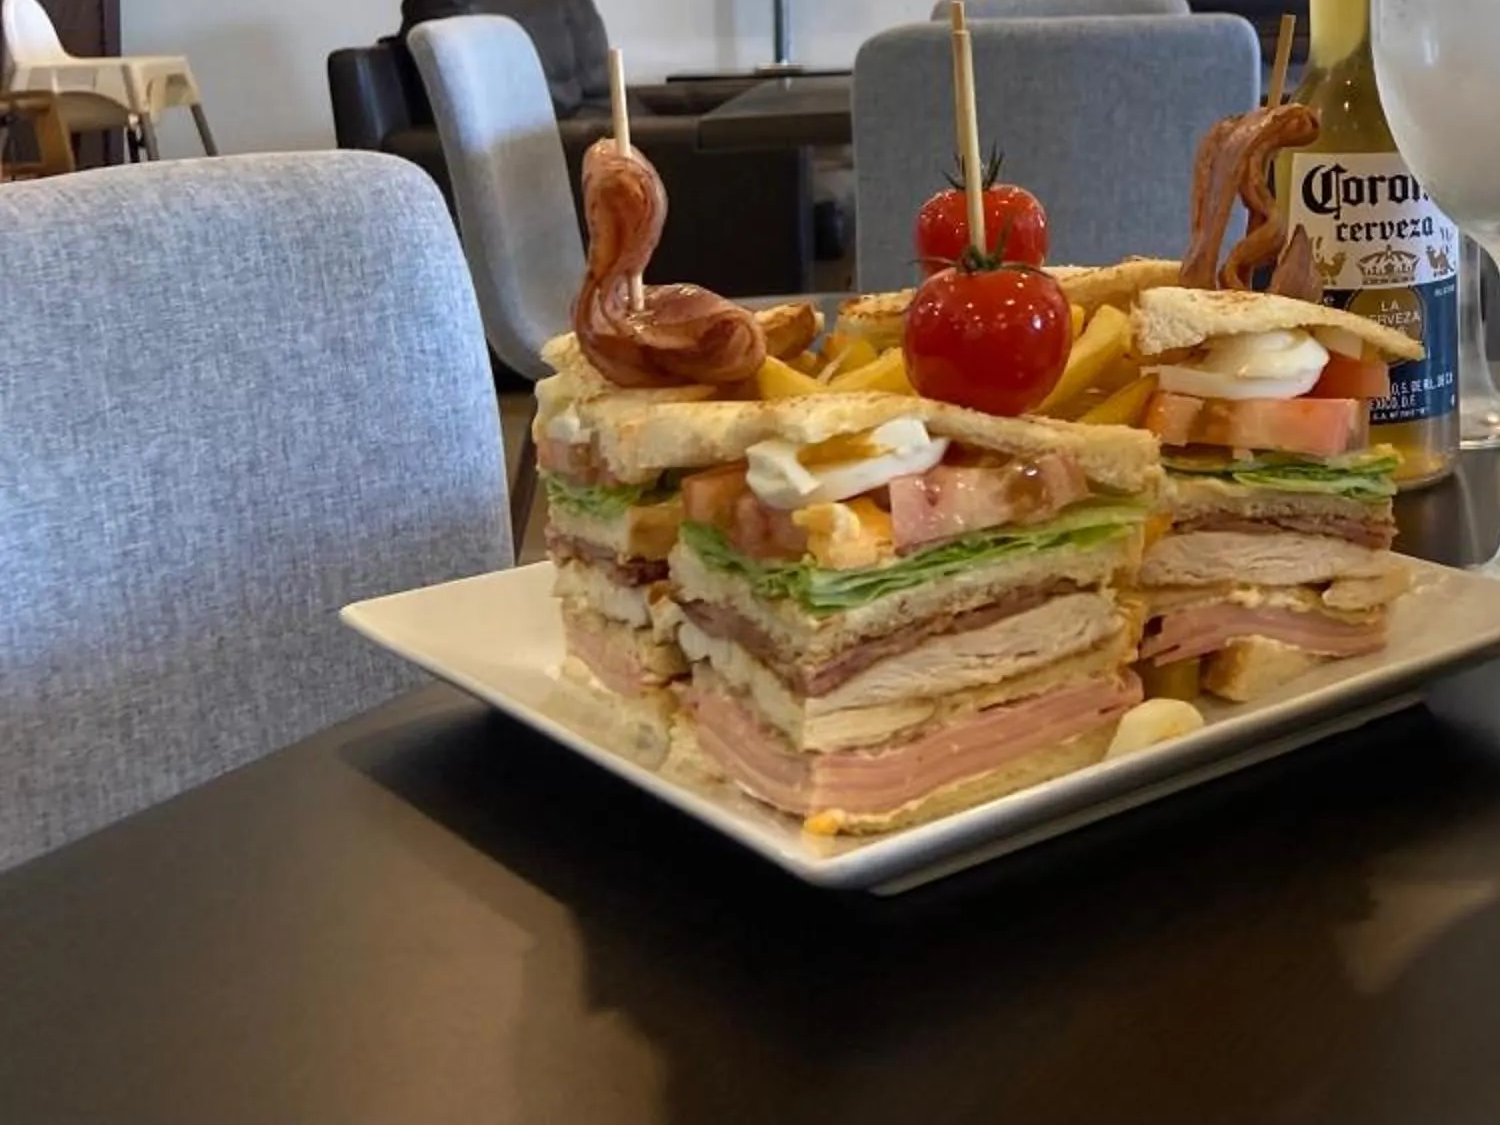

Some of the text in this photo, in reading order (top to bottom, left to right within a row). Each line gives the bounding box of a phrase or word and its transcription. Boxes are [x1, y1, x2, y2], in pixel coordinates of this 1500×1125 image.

[1302, 163, 1429, 220] Coro
[1335, 216, 1434, 242] cerveza
[1381, 300, 1400, 312] LA
[1370, 312, 1421, 325] RVEZA
